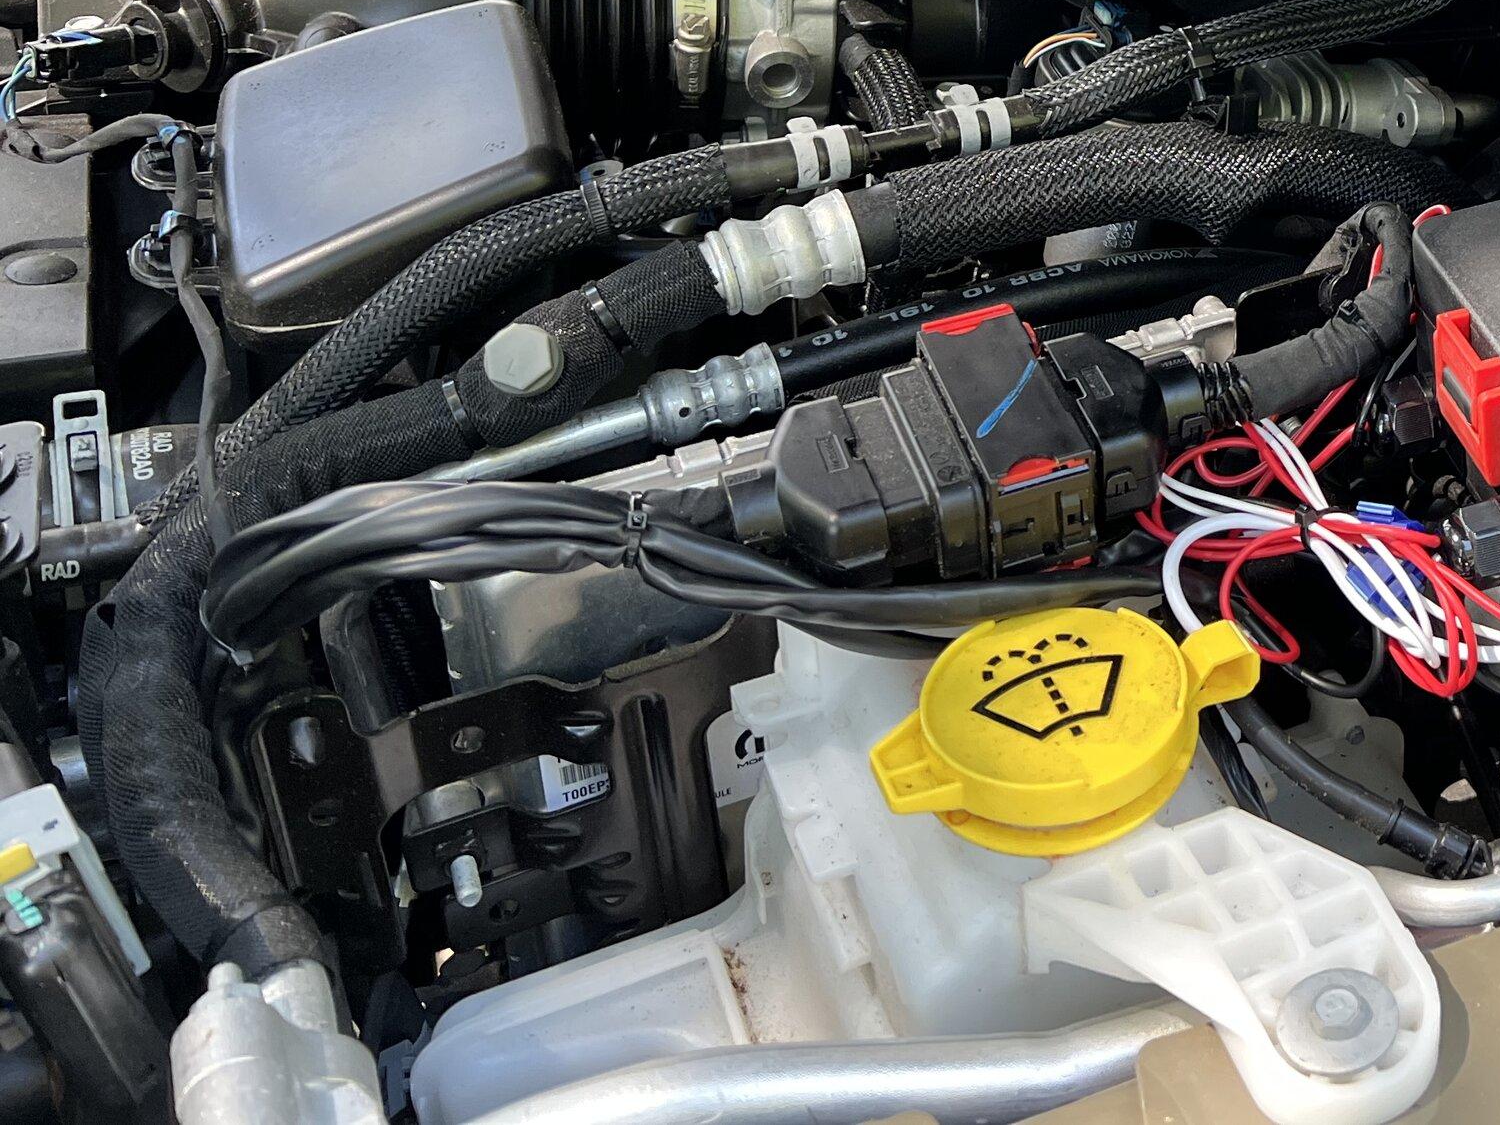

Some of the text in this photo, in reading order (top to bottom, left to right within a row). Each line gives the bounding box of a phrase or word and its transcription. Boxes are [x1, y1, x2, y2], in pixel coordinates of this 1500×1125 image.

[1098, 249, 1193, 267] YOKOHAMA
[1009, 262, 1083, 287] ACBR
[962, 284, 997, 300] 10
[811, 329, 849, 347] 10
[152, 431, 173, 453] RAD
[41, 560, 80, 582] RAD
[714, 787, 731, 799] ULE
